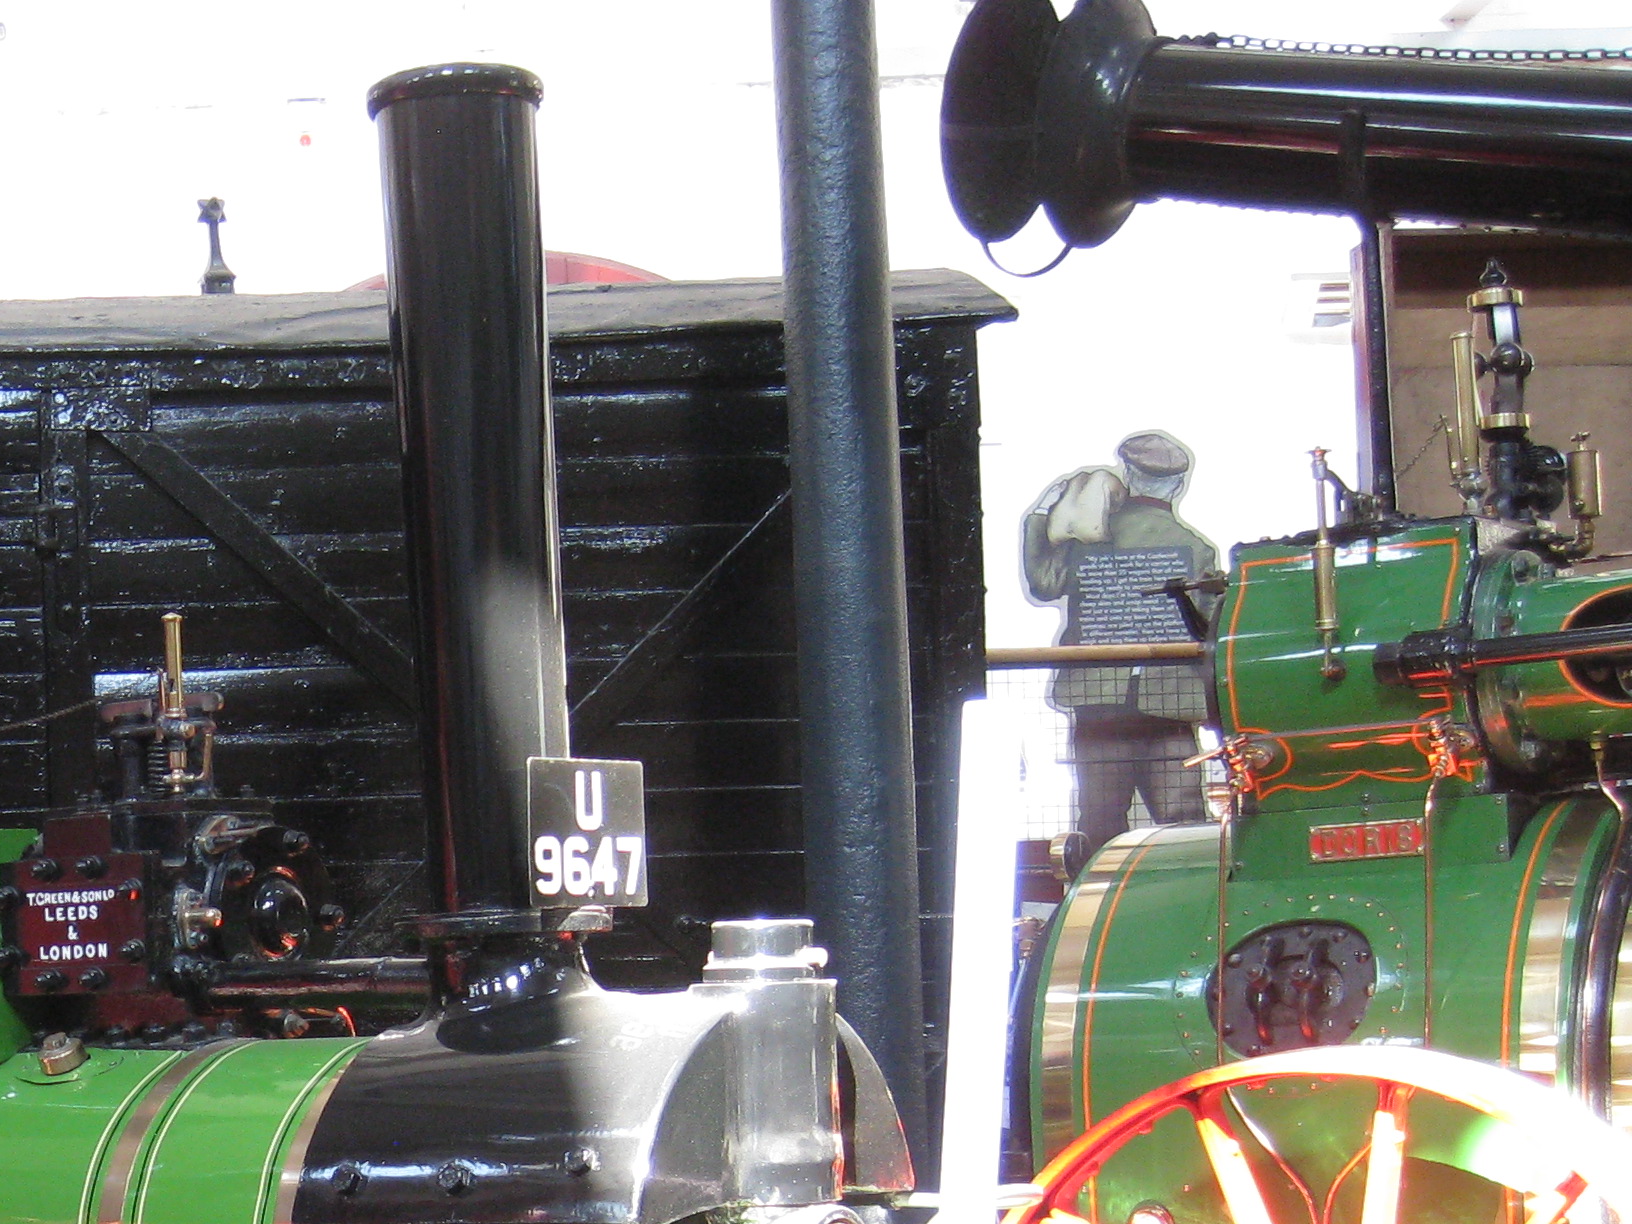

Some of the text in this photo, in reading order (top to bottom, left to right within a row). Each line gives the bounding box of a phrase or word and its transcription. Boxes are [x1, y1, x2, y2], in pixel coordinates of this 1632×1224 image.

[575, 770, 603, 831] U
[534, 835, 643, 897] 9647
[44, 905, 99, 922] LEEDS
[67, 925, 79, 941] &
[39, 943, 109, 961] LONDON
